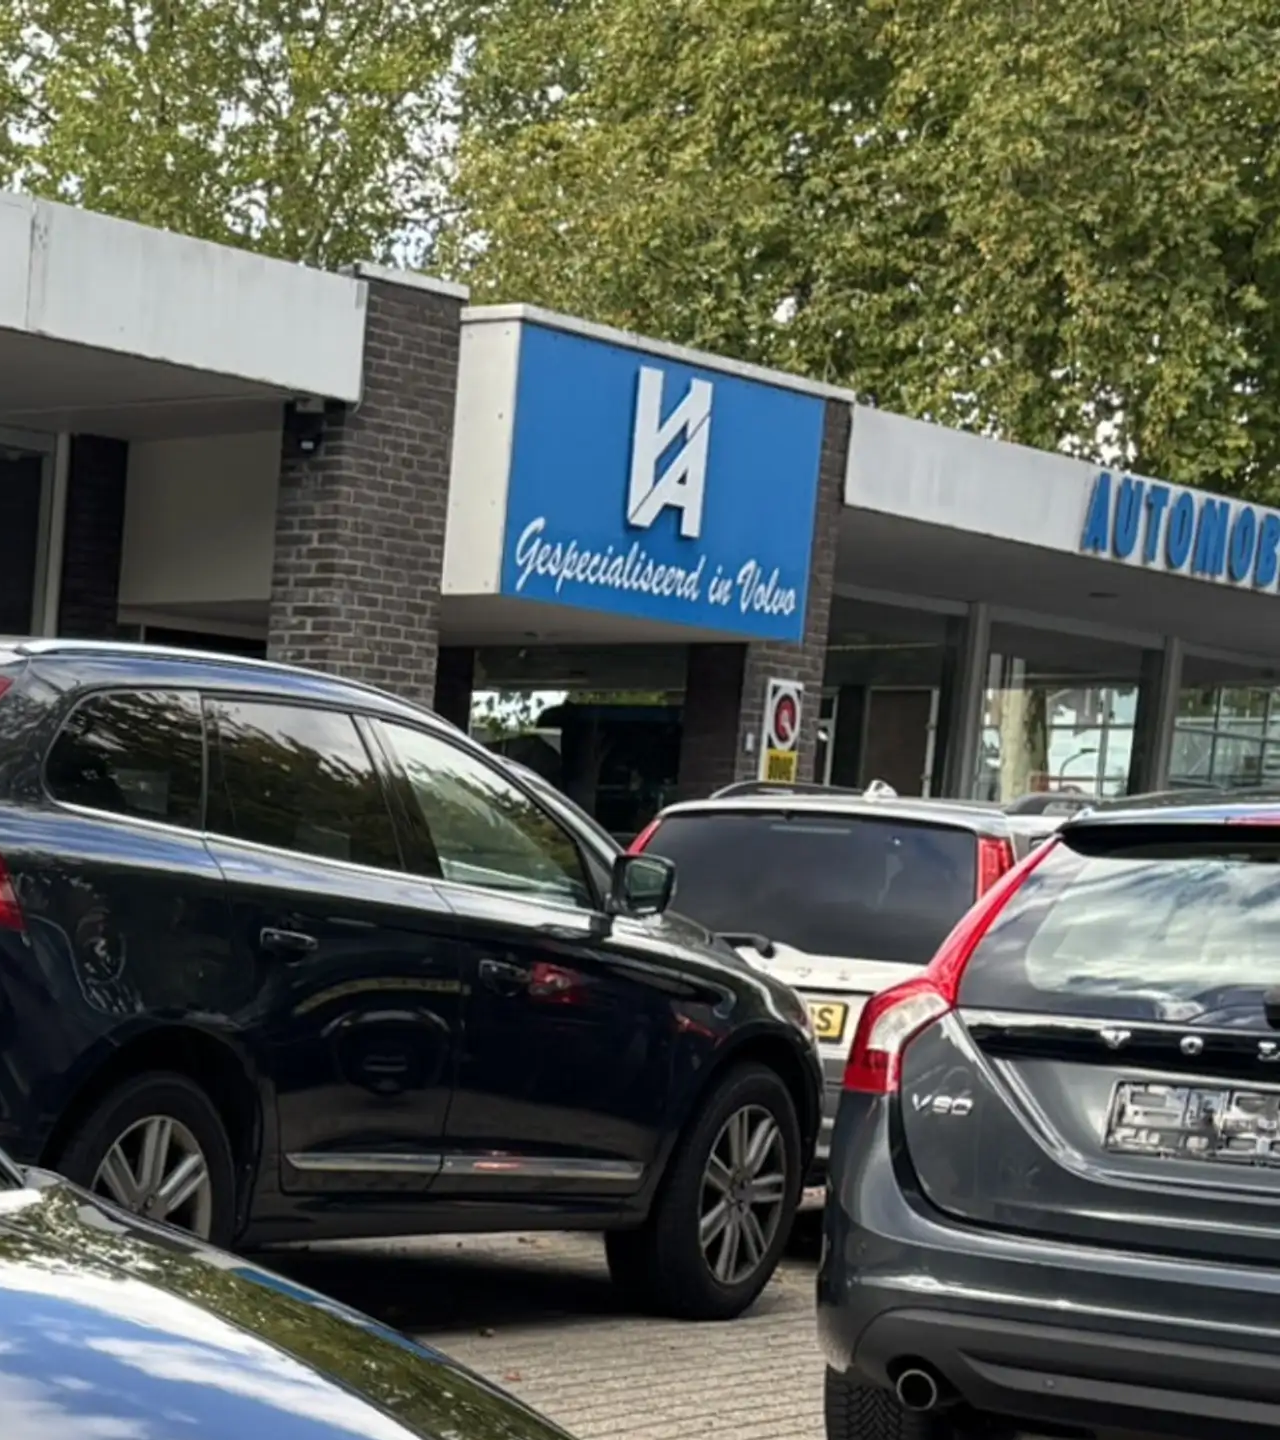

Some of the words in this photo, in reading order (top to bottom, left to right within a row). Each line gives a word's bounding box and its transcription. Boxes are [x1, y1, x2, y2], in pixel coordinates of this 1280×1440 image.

[515, 516, 706, 601] Gespecialiseerd
[708, 564, 732, 606] in
[737, 559, 796, 616] Volvo
